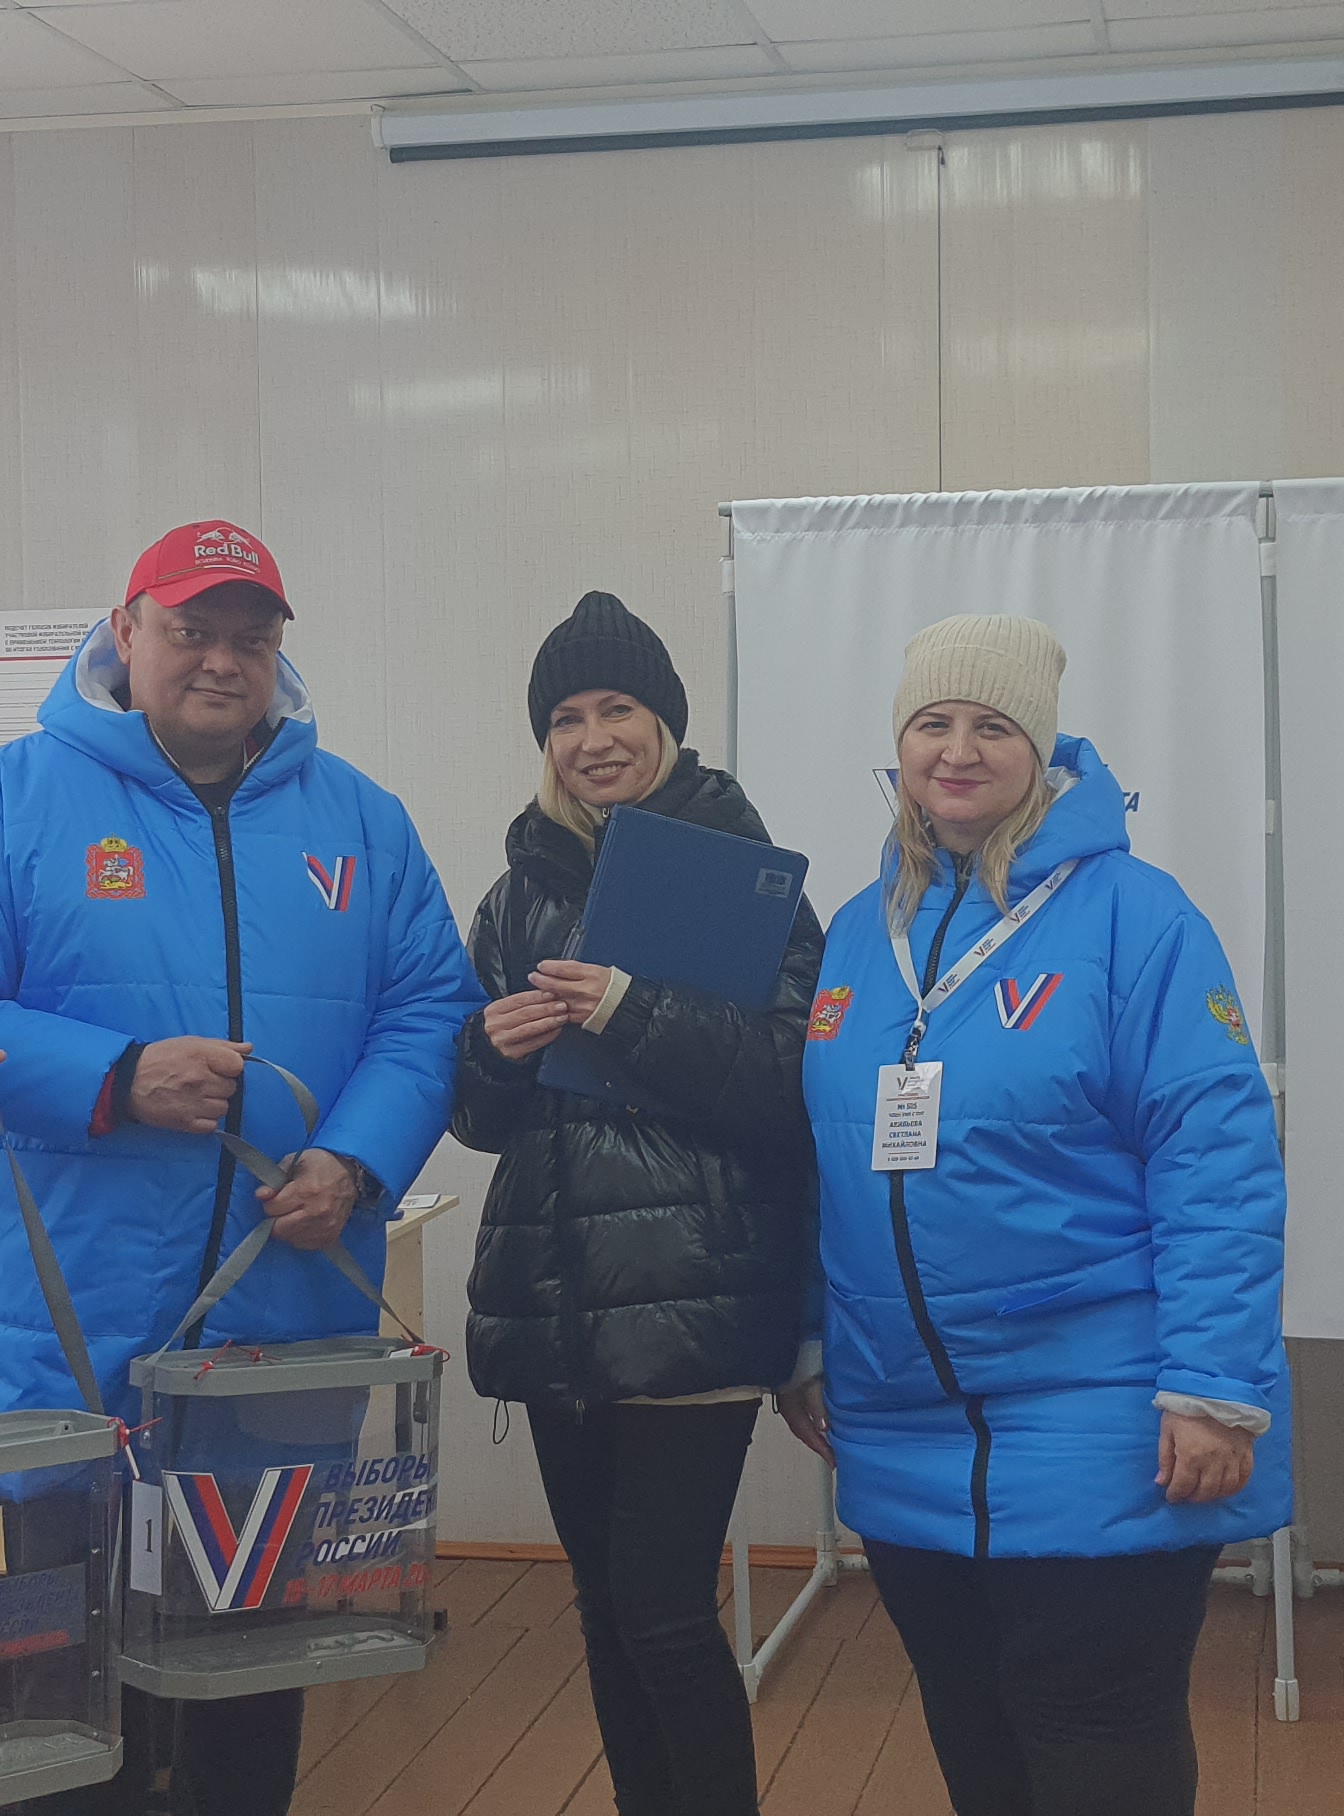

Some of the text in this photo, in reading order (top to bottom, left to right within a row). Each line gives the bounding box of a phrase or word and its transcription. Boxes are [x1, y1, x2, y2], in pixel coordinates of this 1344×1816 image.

[194, 543, 229, 558] Red
[230, 544, 260, 566] Bull
[144, 1518, 154, 1553] 1
[294, 1530, 404, 1569] РОССИИ
